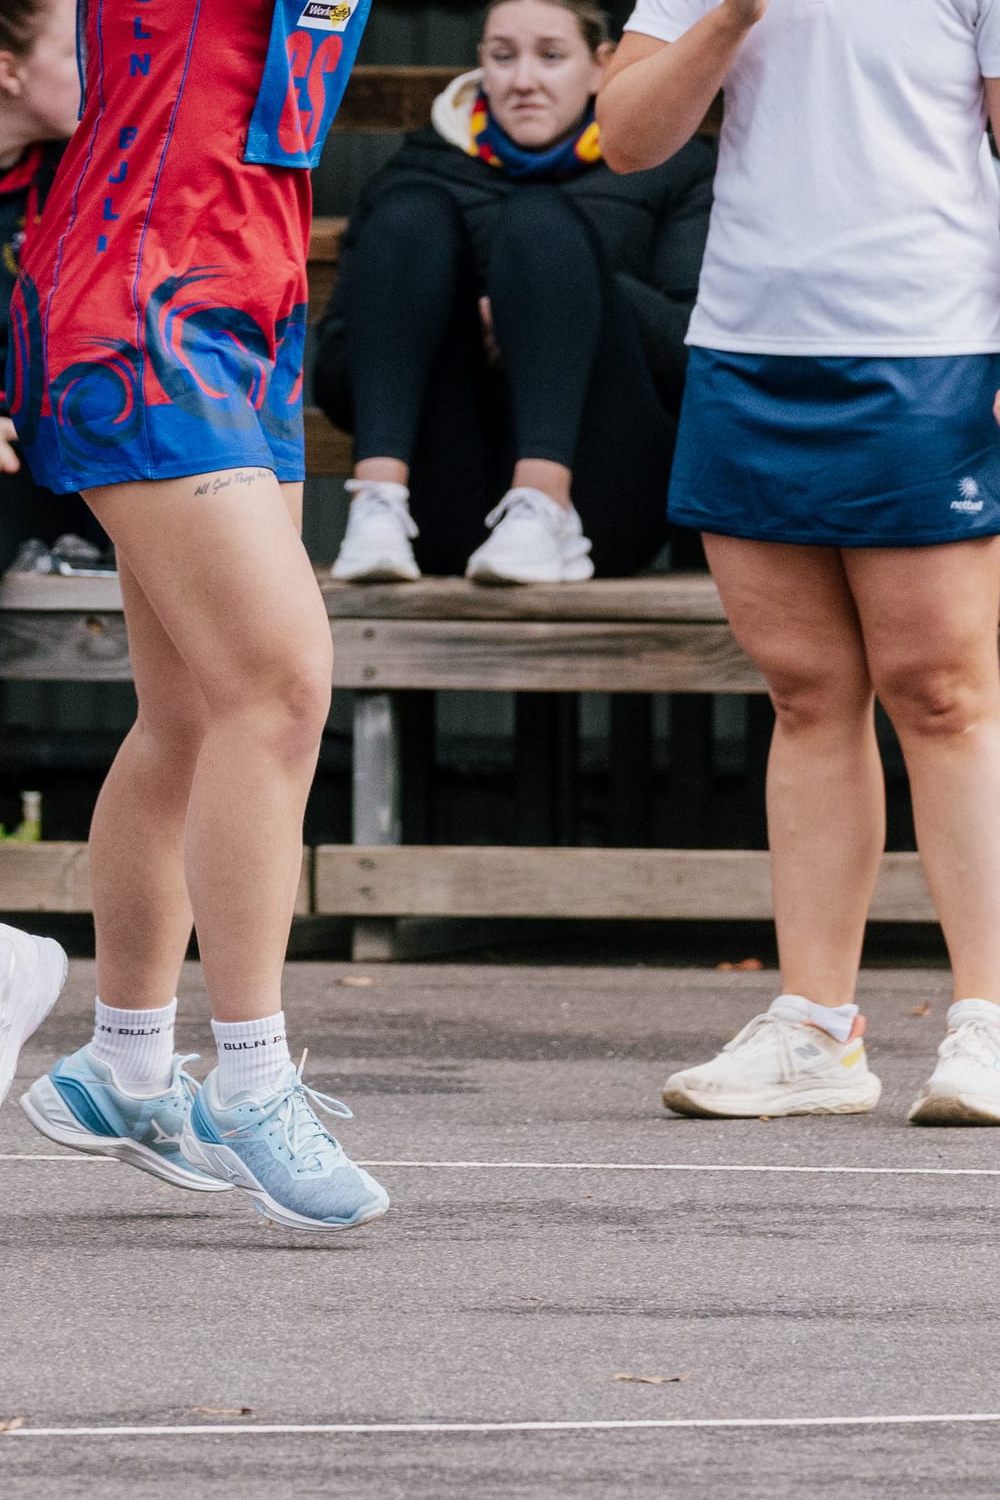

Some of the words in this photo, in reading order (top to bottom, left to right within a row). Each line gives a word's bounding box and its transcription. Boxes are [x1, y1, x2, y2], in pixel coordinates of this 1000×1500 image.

[277, 30, 344, 155] GS
[117, 1027, 161, 1037] BULN
[223, 1039, 267, 1051] BULN
